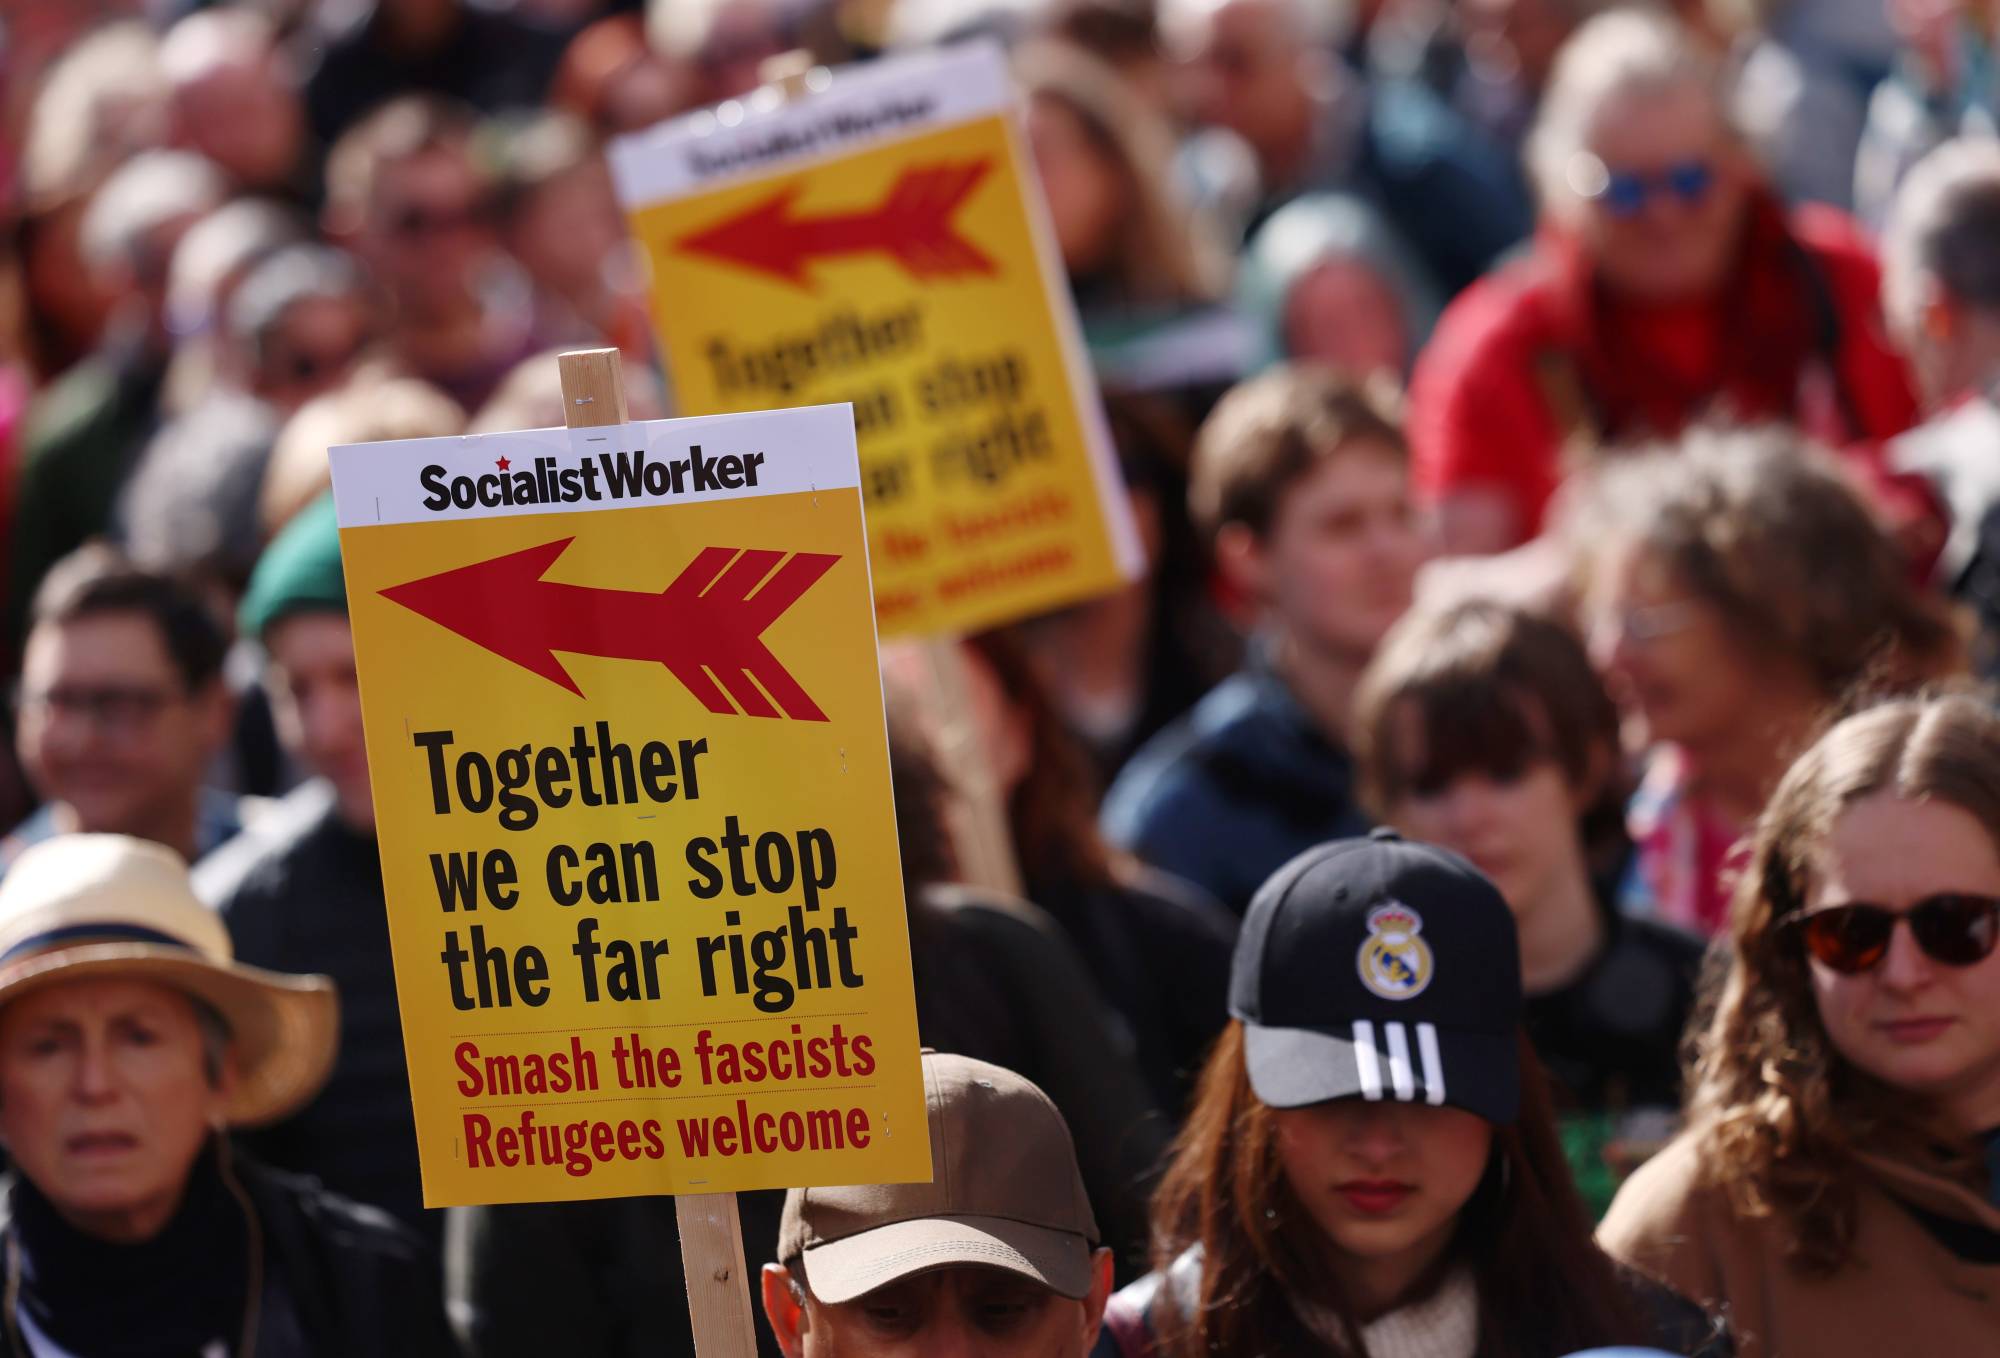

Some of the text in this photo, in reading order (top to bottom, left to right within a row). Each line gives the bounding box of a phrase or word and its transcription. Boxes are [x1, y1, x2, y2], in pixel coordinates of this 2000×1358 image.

[414, 721, 707, 831] Together
[430, 815, 837, 912] we can stop
[440, 905, 864, 1013] the far right
[455, 1024, 876, 1098] Smash the fascists
[462, 1099, 871, 1177] Refugees welcome
